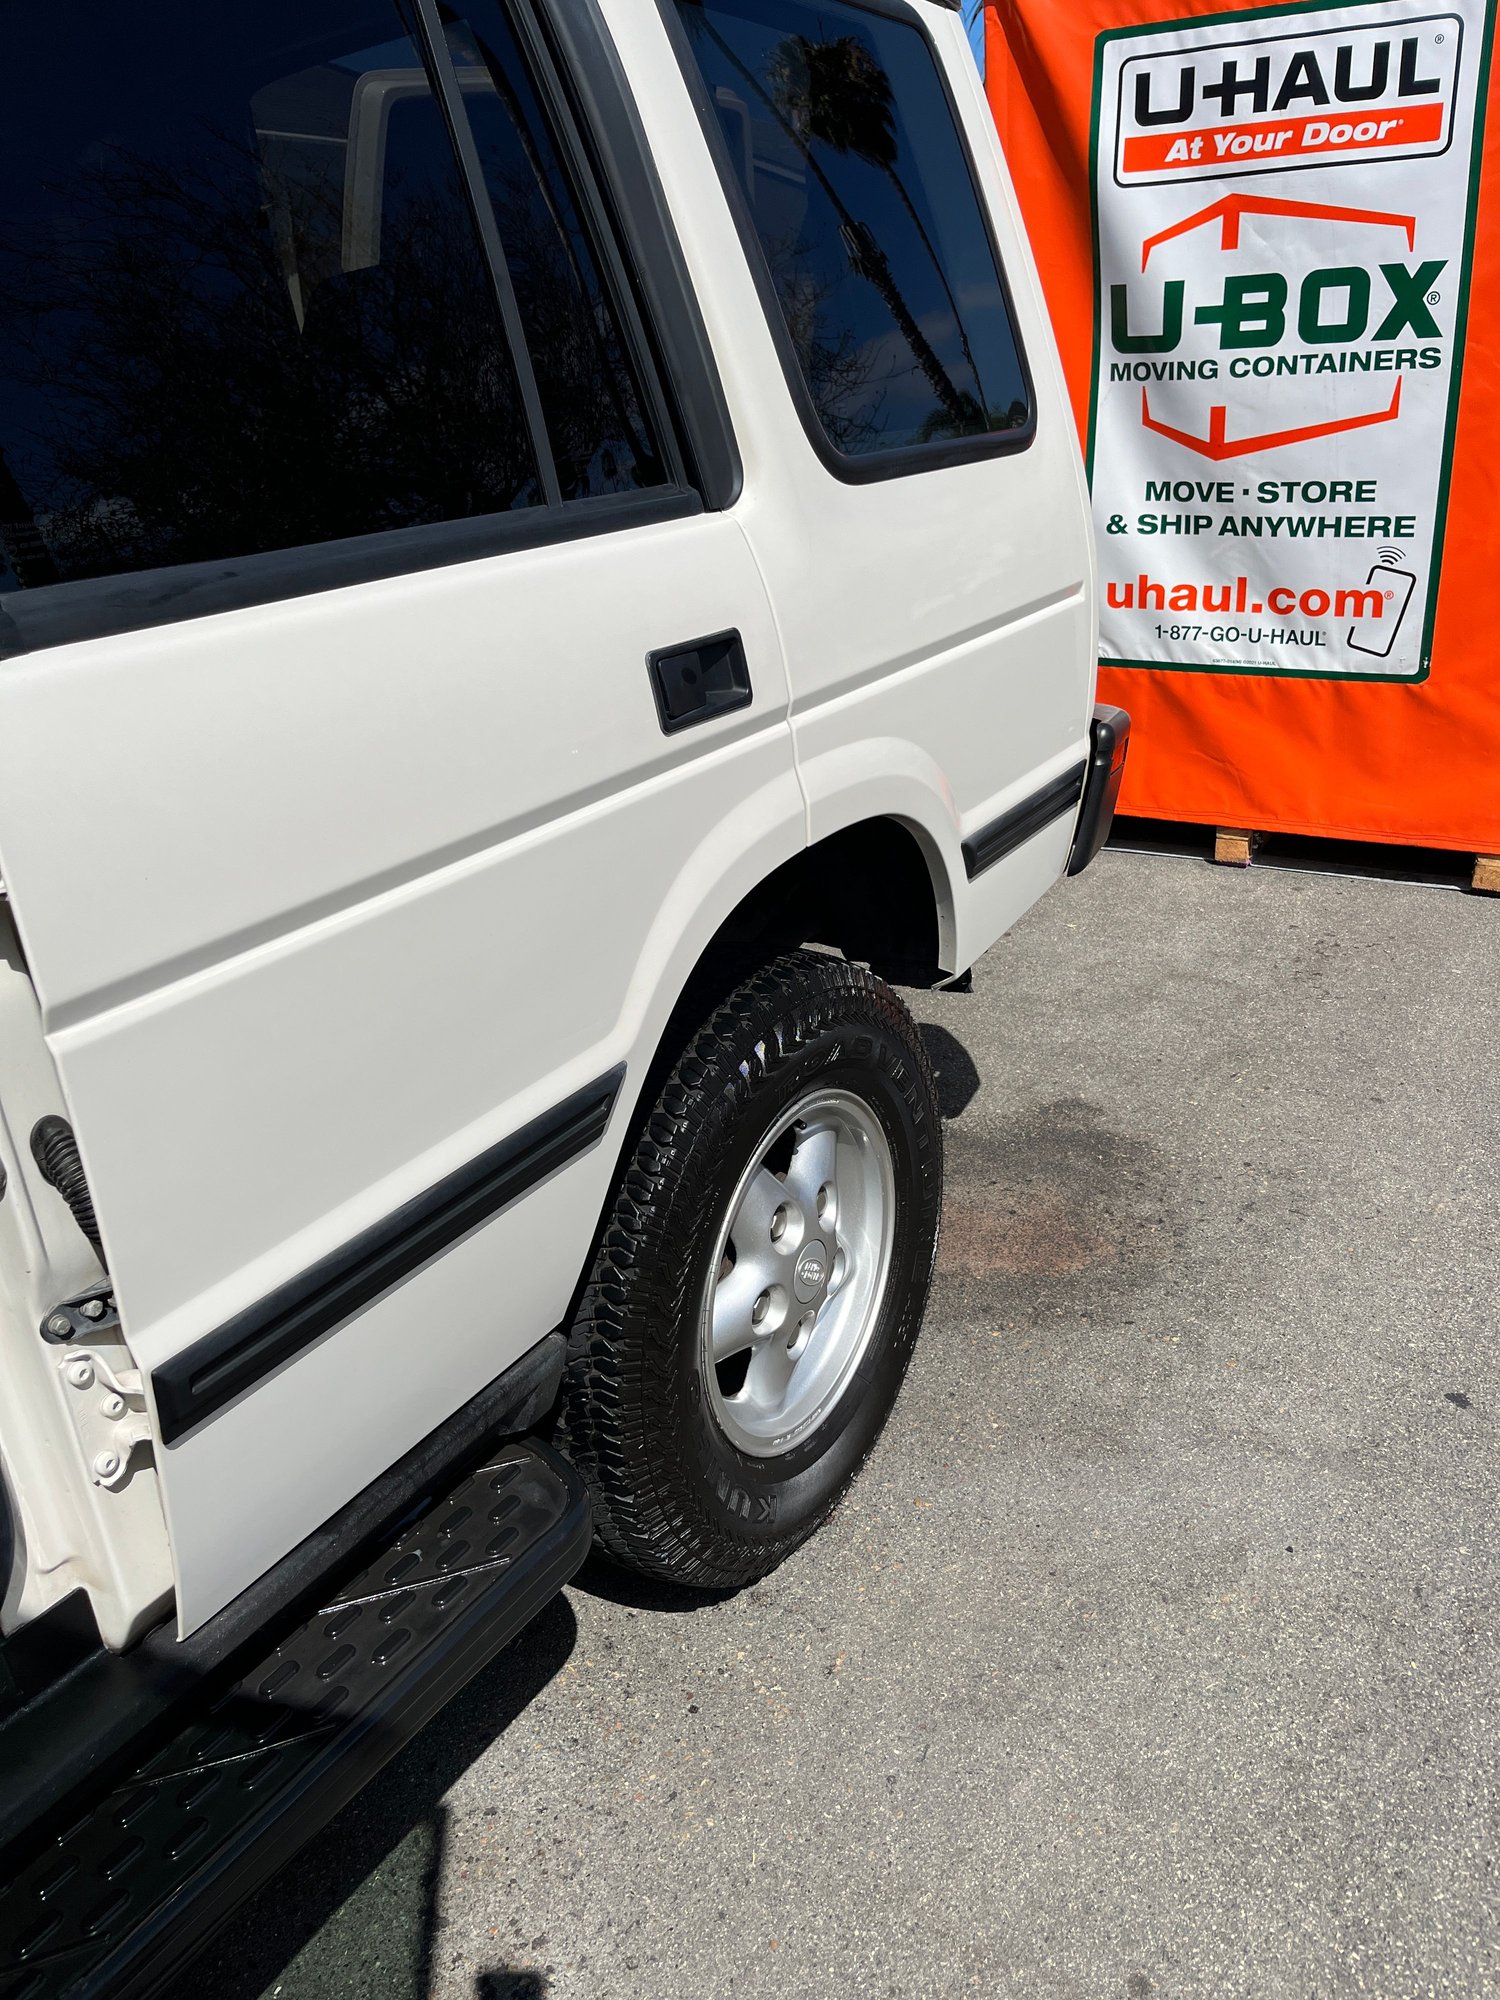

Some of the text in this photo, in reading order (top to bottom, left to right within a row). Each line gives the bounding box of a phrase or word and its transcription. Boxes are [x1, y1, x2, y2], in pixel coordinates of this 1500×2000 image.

[1164, 136, 1203, 163] At
[1213, 128, 1293, 156] Your
[1110, 347, 1441, 382] MOVING CONTAINERS
[1145, 480, 1377, 503] MOVE STORE
[1106, 514, 1416, 538] & SHIP ANYWHERE
